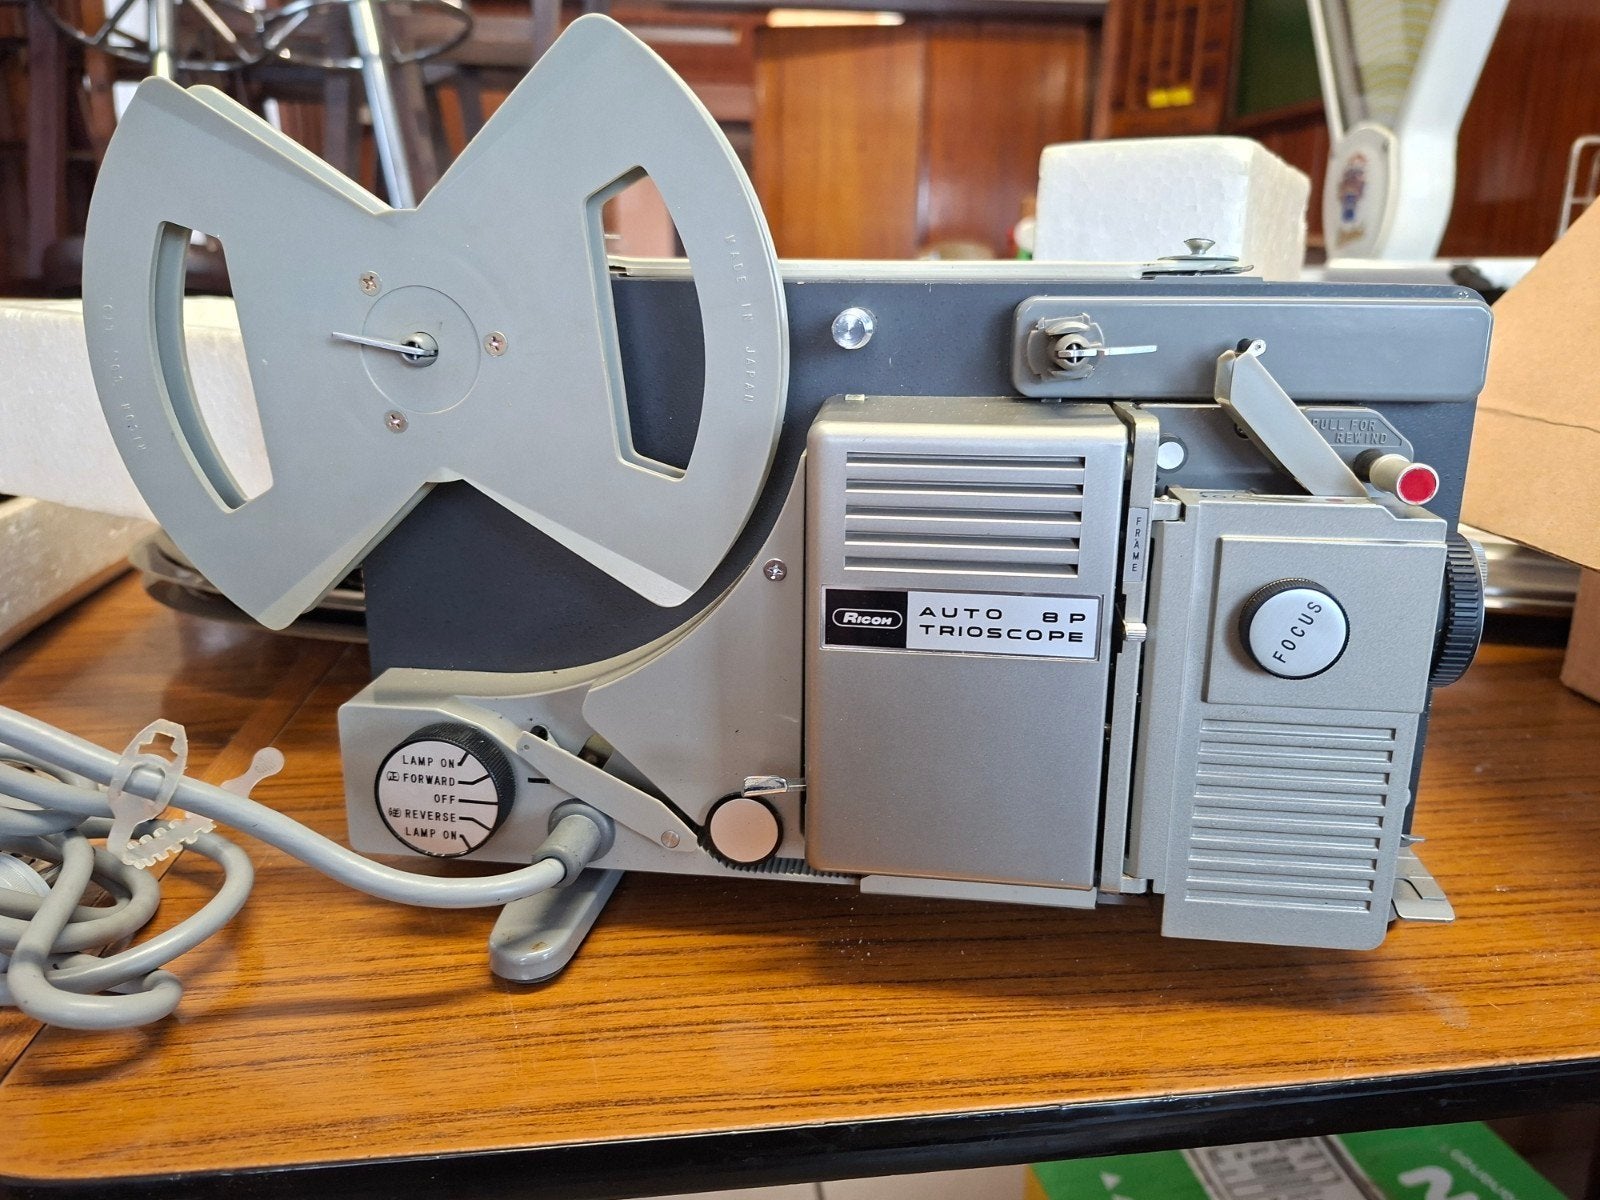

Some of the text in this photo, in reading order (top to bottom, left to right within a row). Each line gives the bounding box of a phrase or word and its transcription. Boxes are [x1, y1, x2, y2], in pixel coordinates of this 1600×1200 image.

[725, 234, 756, 402] MADE IN JAPAN
[1312, 418, 1376, 432] PULL FOR
[1335, 431, 1388, 444] REWIND
[1131, 516, 1142, 572] FRAME
[842, 611, 893, 625] RICOH
[919, 606, 1003, 620] AUTO
[919, 624, 1084, 643] TRIOSCOPE
[1272, 601, 1323, 664] FOCUS
[402, 754, 455, 769] LAMP ON
[403, 773, 456, 786] FORWARD
[434, 793, 456, 805] OFF
[405, 809, 456, 822] REVERSE
[405, 826, 457, 840] LAMP ON
